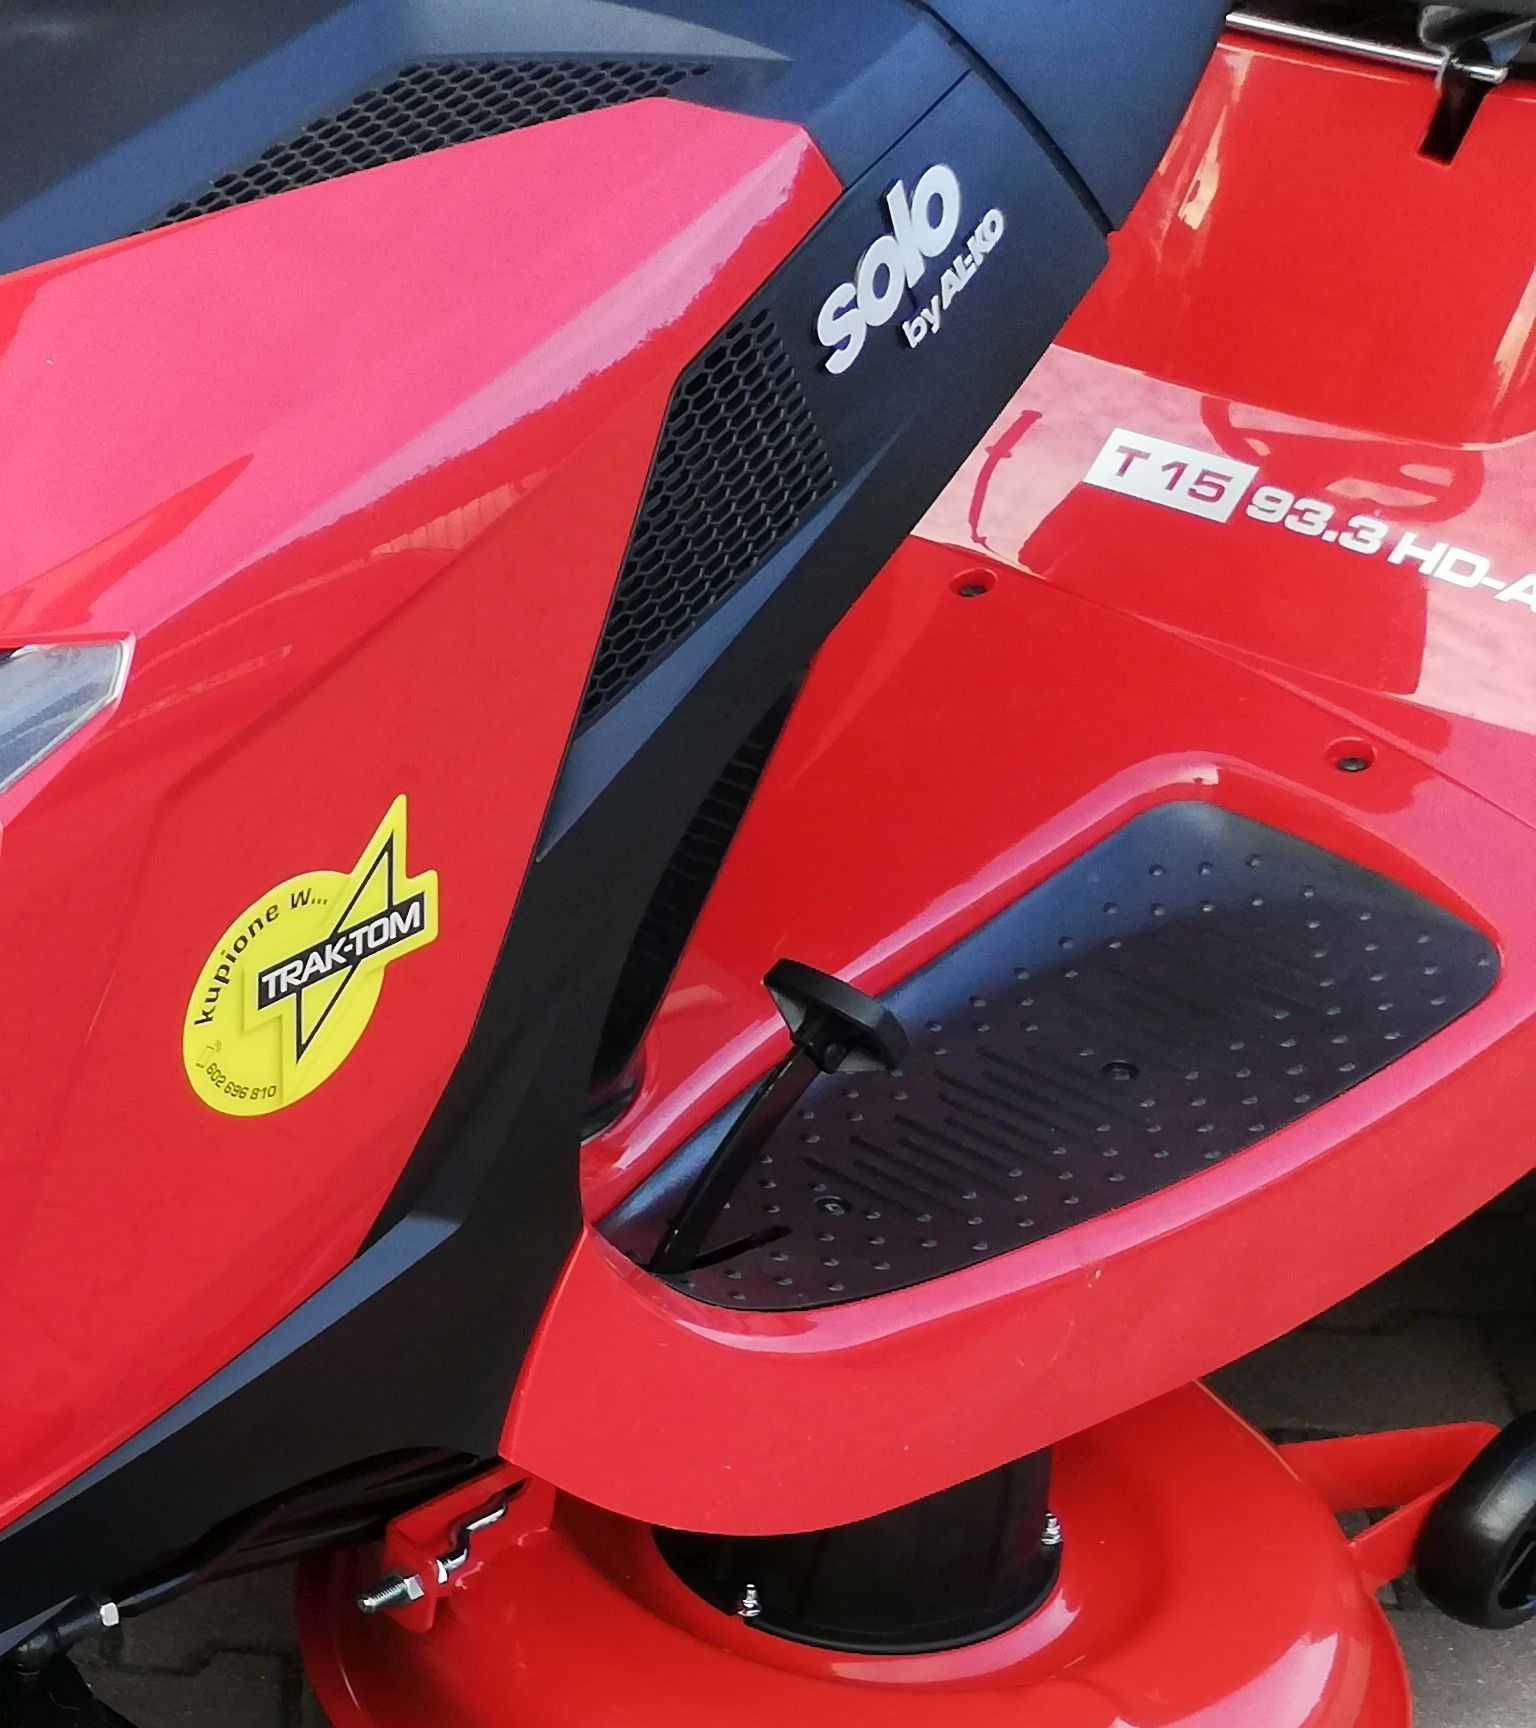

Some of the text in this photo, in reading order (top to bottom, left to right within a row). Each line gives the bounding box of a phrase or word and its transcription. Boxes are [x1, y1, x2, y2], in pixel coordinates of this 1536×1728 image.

[817, 164, 961, 374] solo
[902, 208, 1005, 349] by AL-KO
[1115, 445, 1150, 478] T
[1159, 459, 1233, 502] 15
[1245, 485, 1390, 554] 93.3
[194, 903, 280, 1026] kupione
[261, 901, 421, 999] TRAK-TOM
